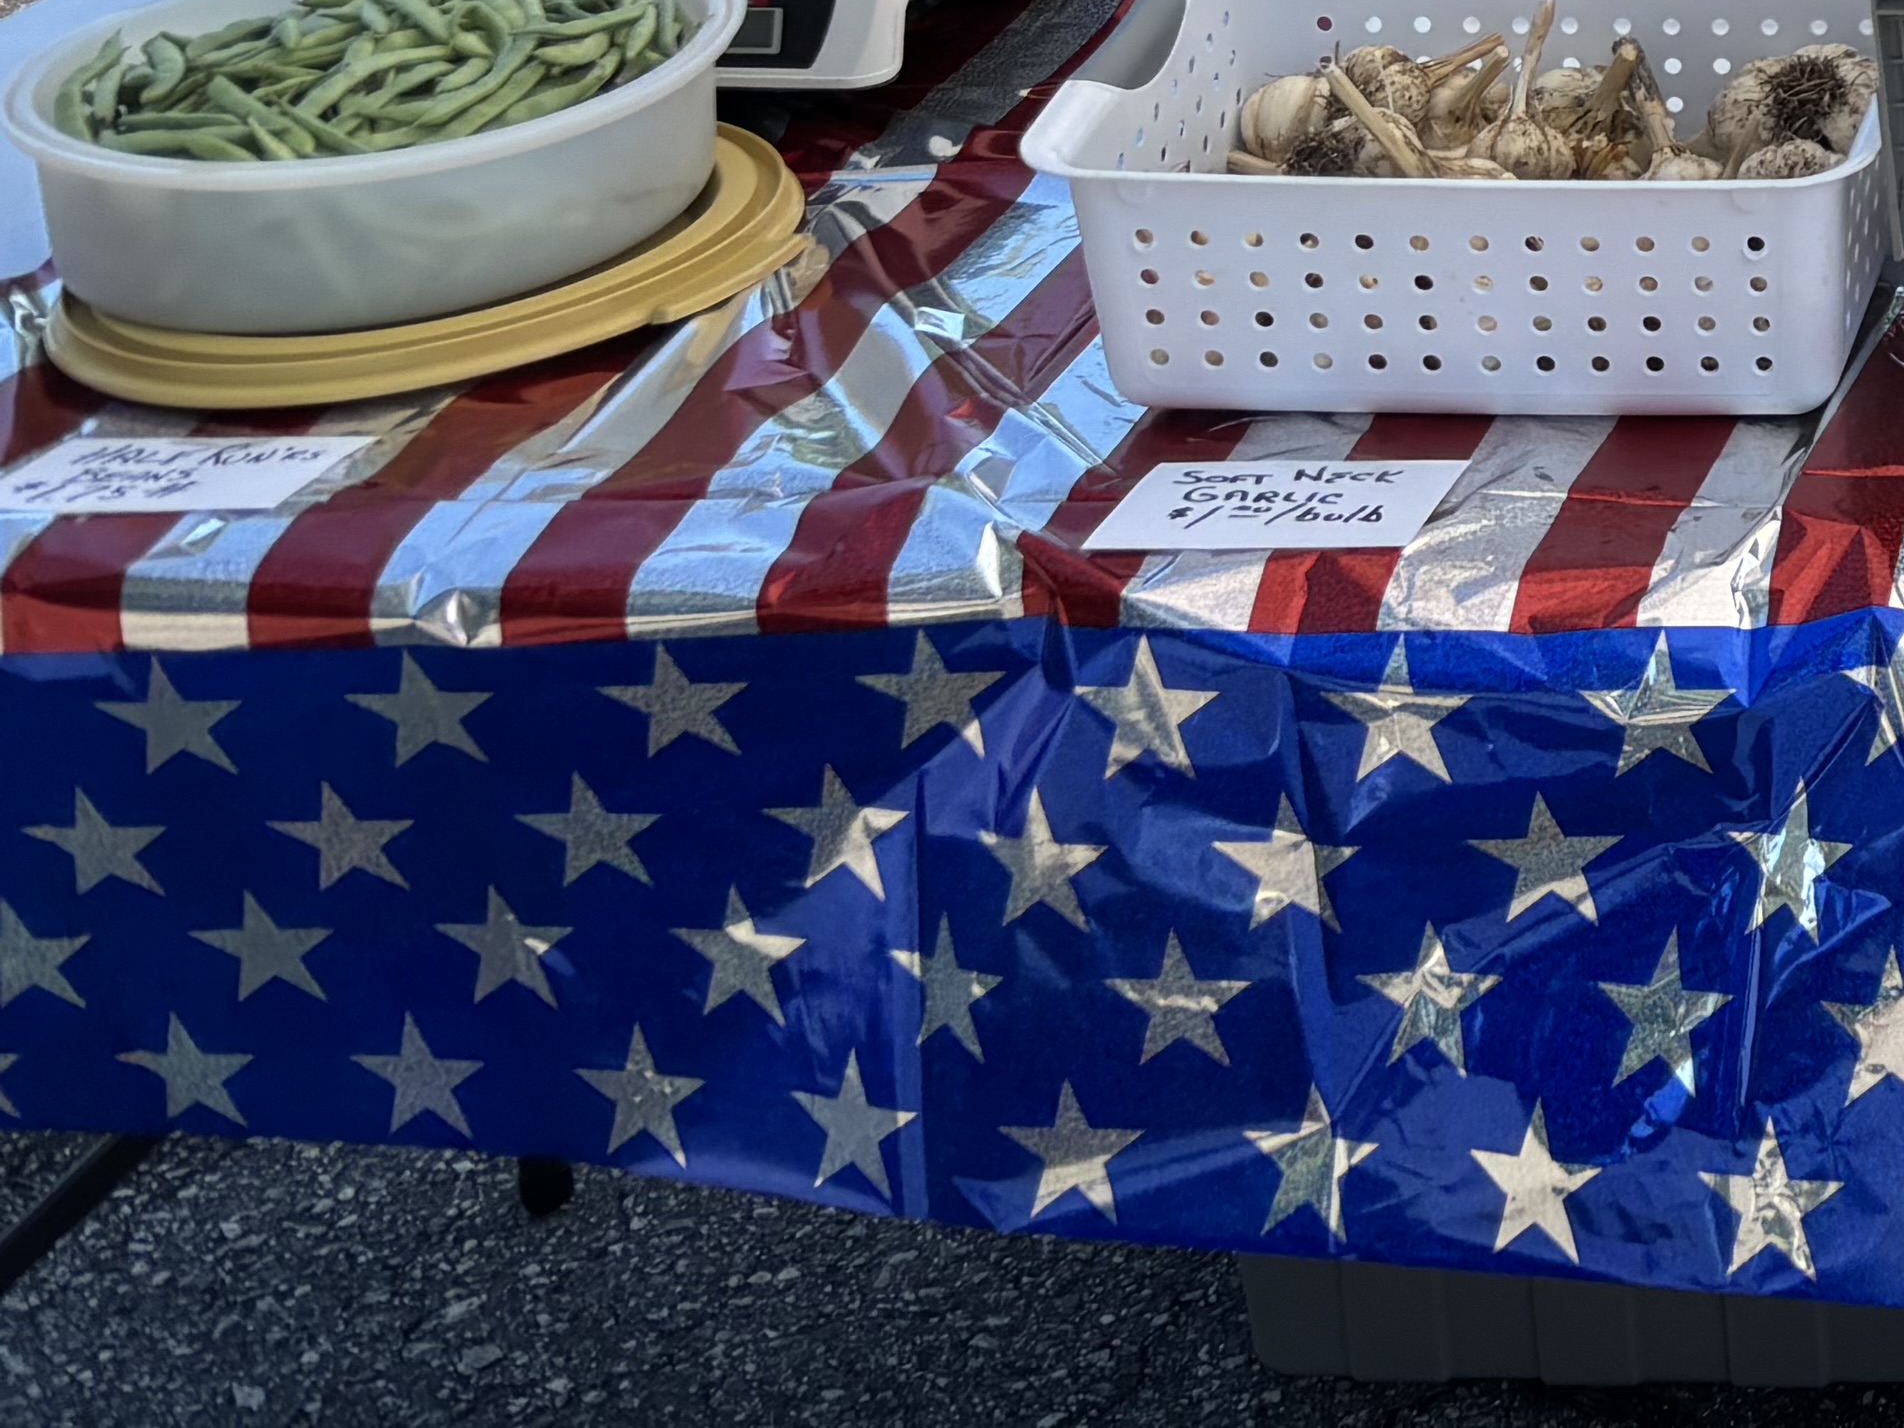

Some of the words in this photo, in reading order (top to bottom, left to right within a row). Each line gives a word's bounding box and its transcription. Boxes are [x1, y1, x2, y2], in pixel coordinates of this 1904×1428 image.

[1172, 470, 1274, 485] SOFT
[1293, 465, 1405, 484] NECK
[1182, 485, 1344, 504] GARLIC
